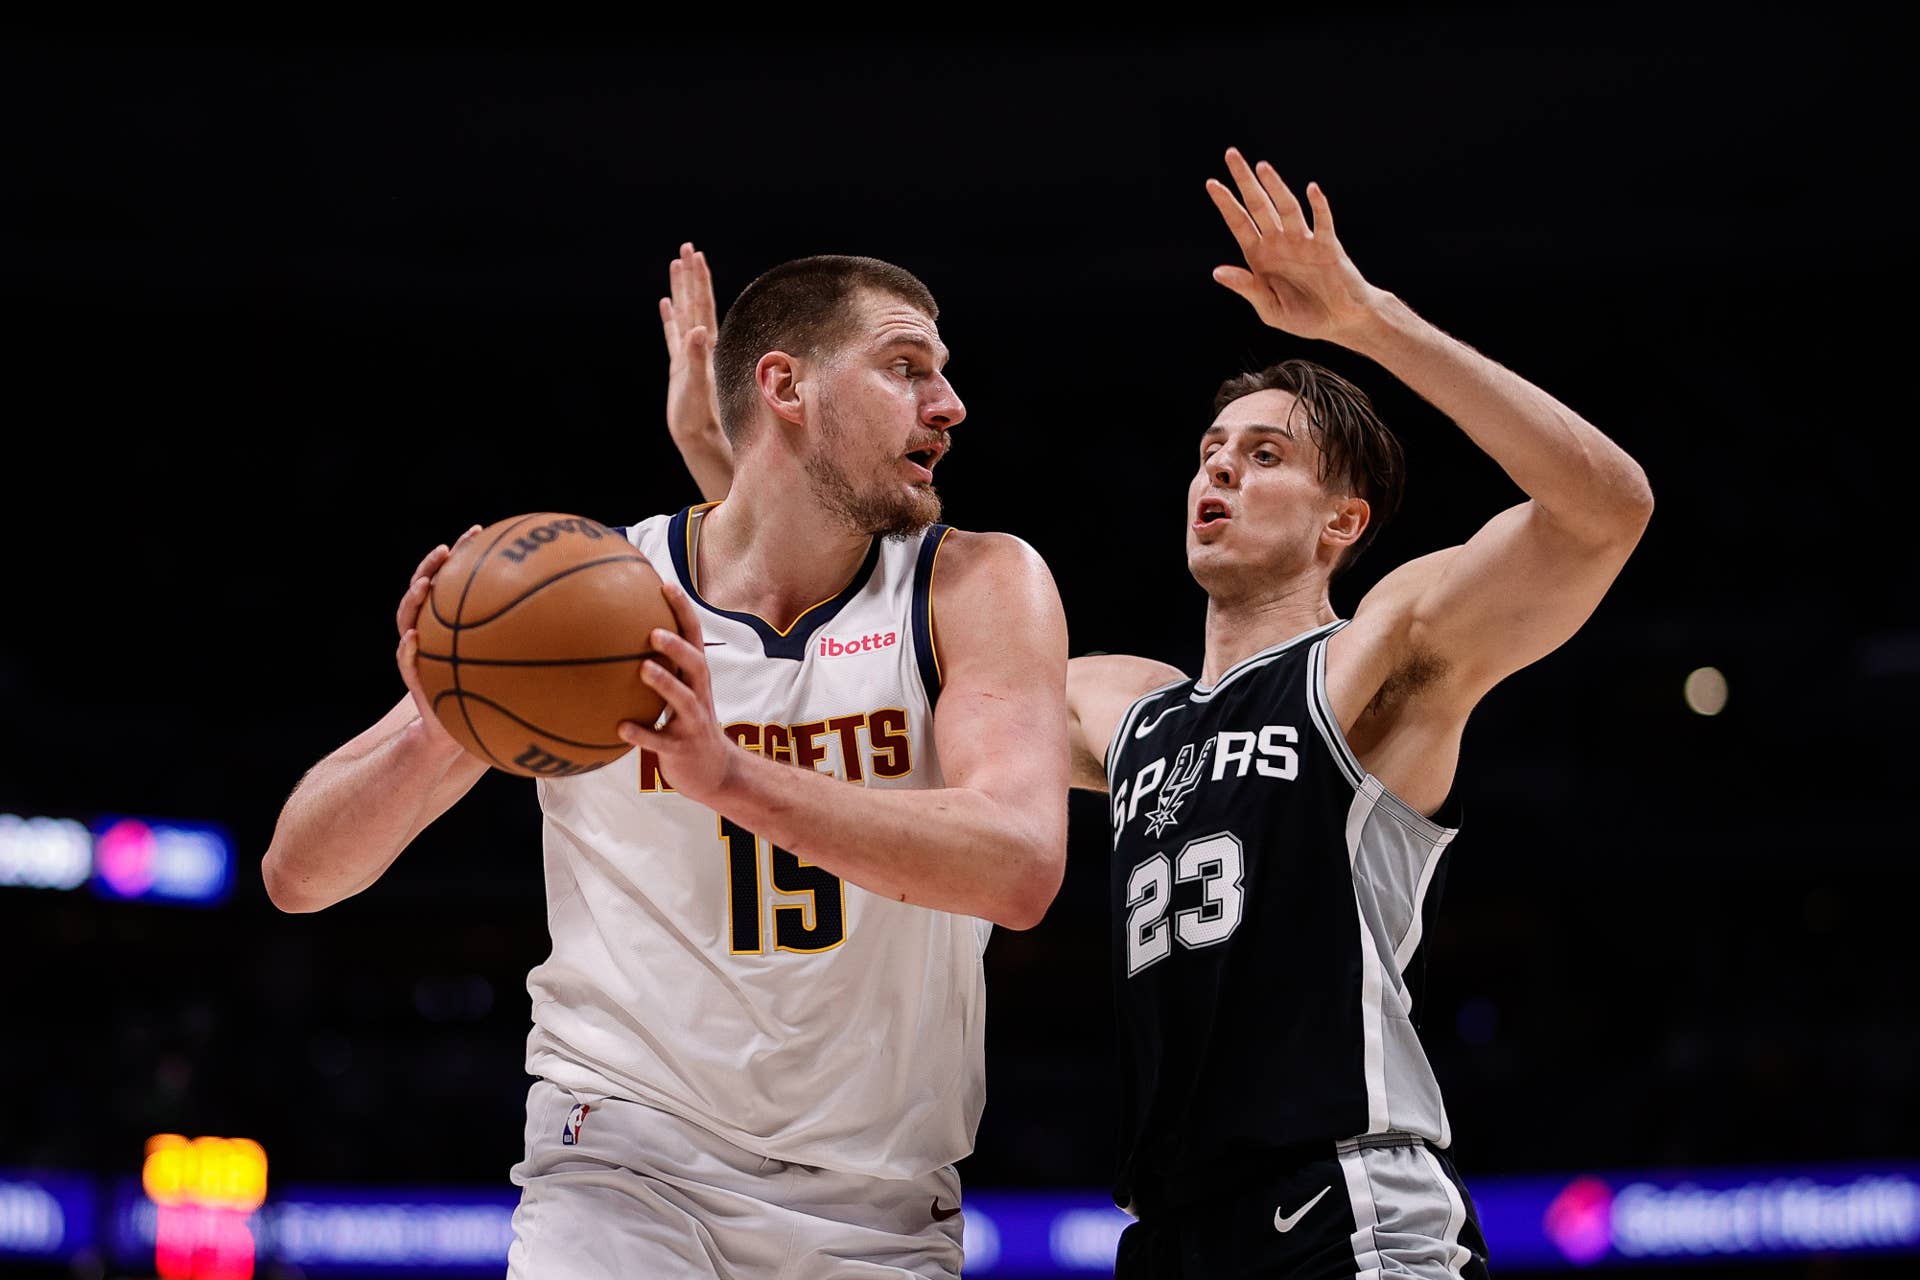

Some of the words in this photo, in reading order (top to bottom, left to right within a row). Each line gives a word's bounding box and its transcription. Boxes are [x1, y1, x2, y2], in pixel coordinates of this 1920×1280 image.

[820, 632, 896, 656] ibotta
[1114, 725, 1299, 852] SPURS
[717, 814, 847, 955] 15
[1126, 830, 1245, 979] 23
